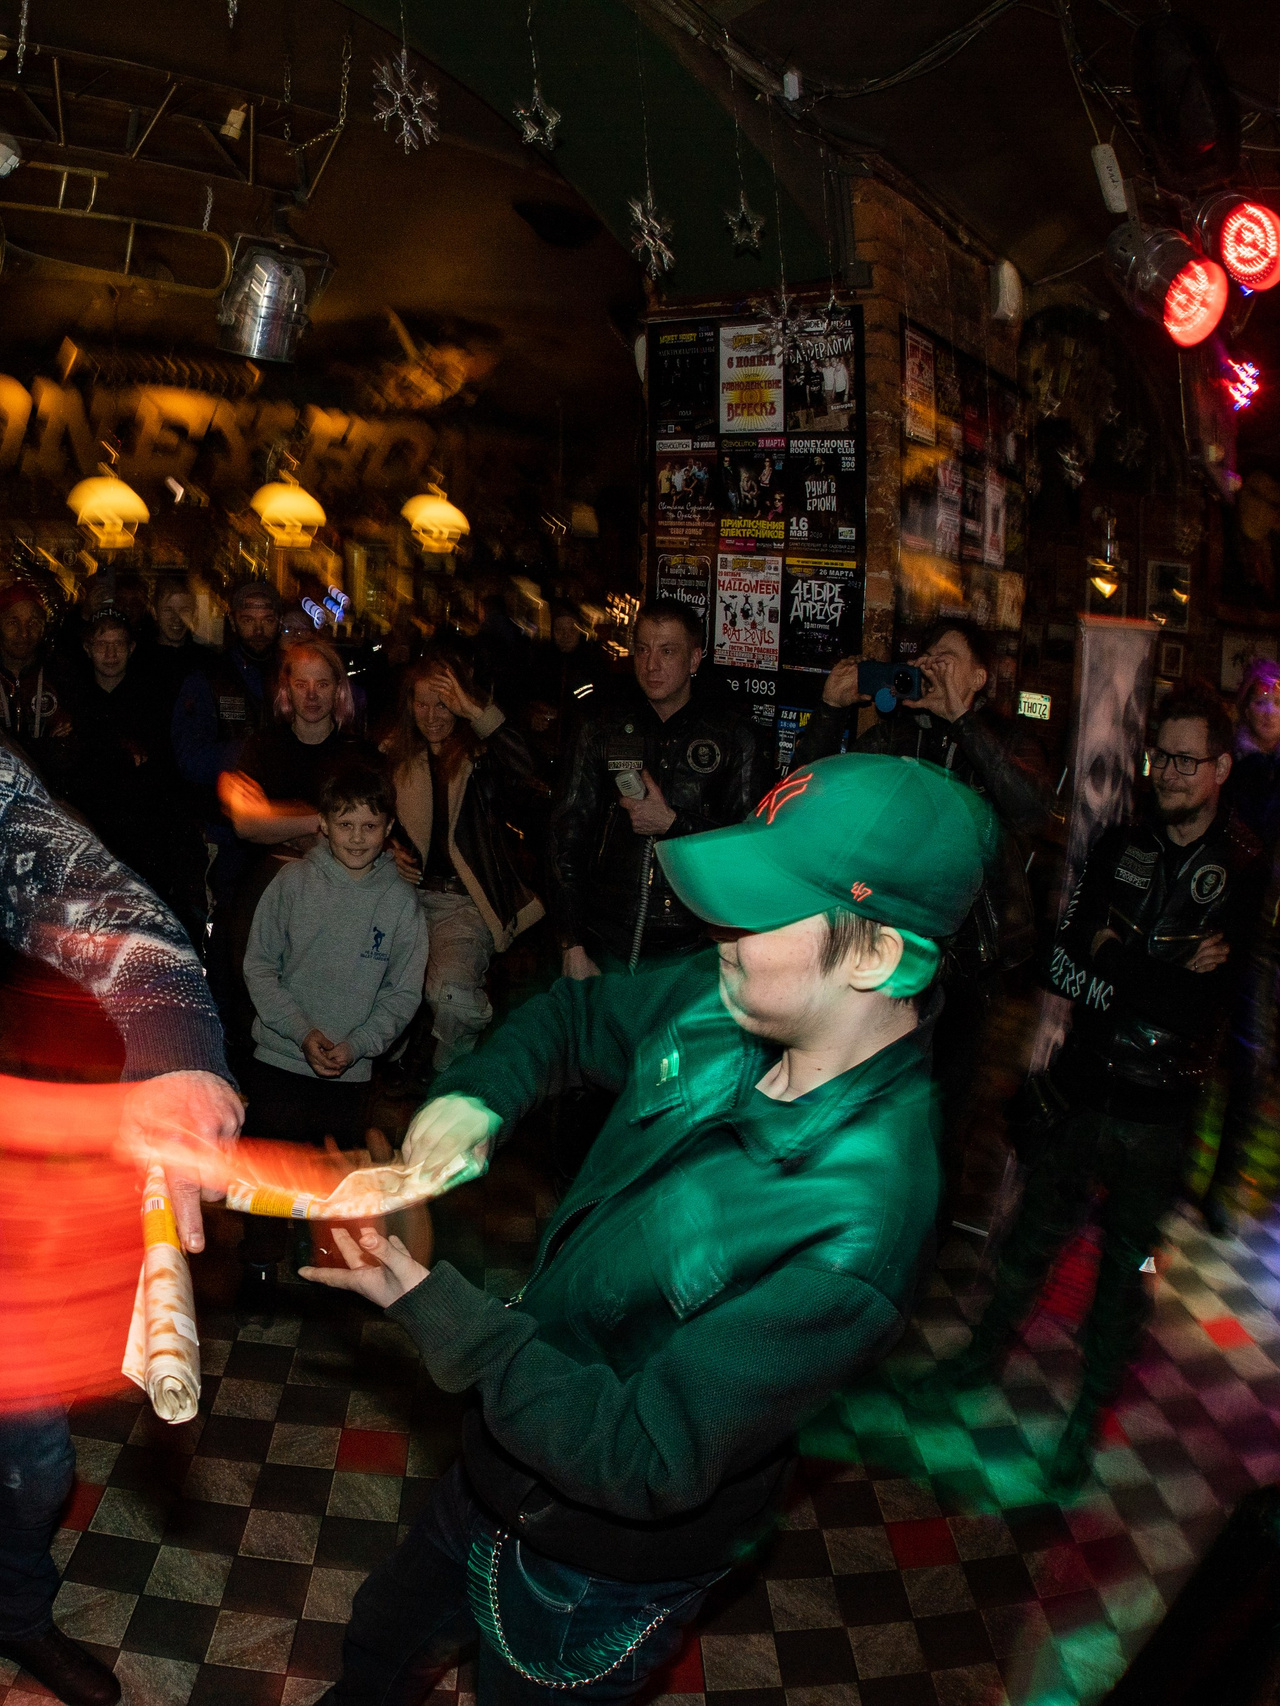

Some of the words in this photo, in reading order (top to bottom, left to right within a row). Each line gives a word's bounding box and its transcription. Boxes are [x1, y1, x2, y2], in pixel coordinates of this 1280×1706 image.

[727, 357, 734, 368] 6
[736, 354, 776, 368] НОЯБРЯ
[766, 439, 785, 447] МАРТА
[790, 440, 855, 448] MONEY-HONEY
[807, 496, 837, 512] БРЮКИ
[720, 519, 785, 530] ПРИКЛЮЧЕНИЯ
[790, 517, 808, 530] 16
[720, 528, 785, 539] ЭЛЕКТРОНИКОВ
[829, 570, 854, 578] МАРТА
[718, 579, 779, 595] HALLOWEEN
[789, 596, 846, 627] АПРЕЛЯ
[900, 640, 918, 654] since
[744, 678, 776, 696] 1993
[1086, 976, 1114, 1011] MC
